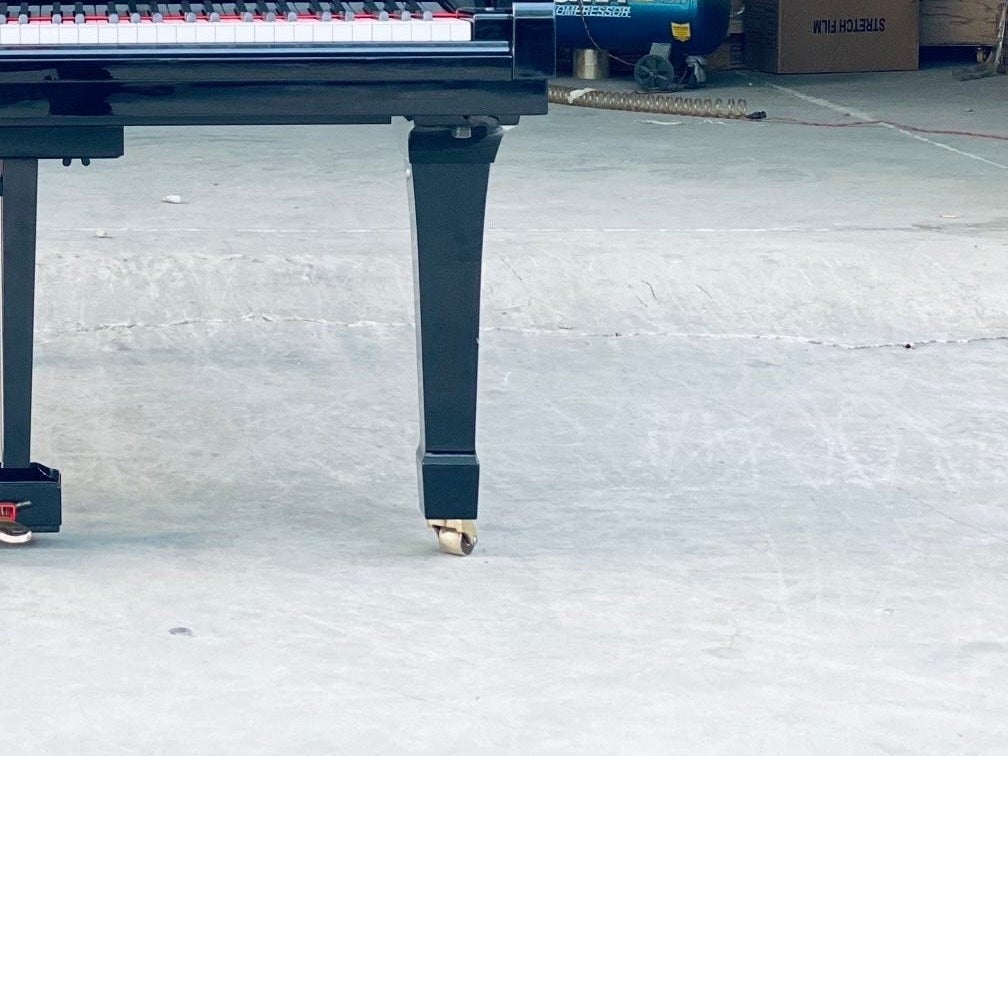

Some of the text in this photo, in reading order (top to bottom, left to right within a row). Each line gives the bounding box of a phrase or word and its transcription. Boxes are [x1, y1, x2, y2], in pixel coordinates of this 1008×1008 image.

[555, 5, 630, 17] OMPRESSOR
[813, 18, 885, 34] STRETCH FILM
